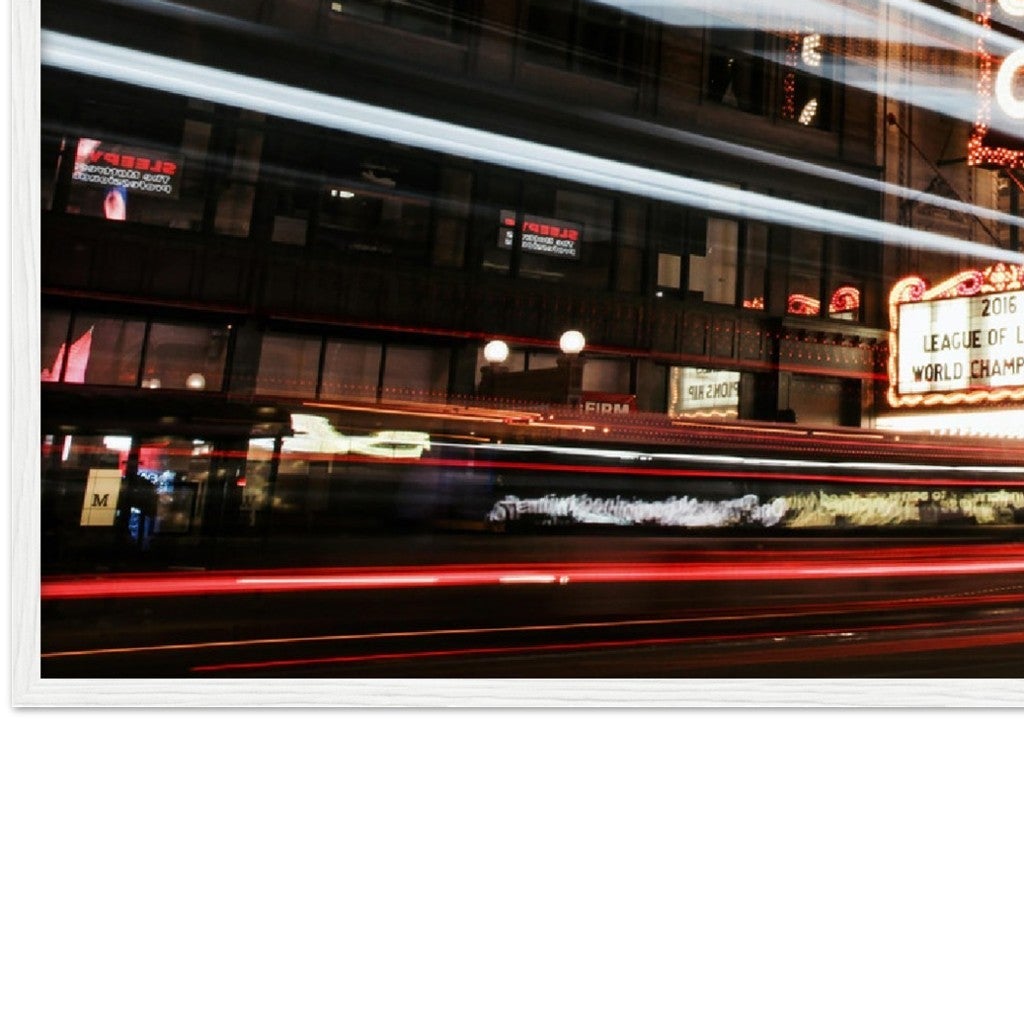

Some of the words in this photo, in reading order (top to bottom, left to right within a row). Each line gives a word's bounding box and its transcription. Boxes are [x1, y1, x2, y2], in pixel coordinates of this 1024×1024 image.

[981, 296, 1018, 317] 2016
[923, 329, 982, 352] LEAGUE
[988, 327, 1008, 346] OF
[911, 362, 963, 382] WORLD
[91, 493, 110, 508] M
